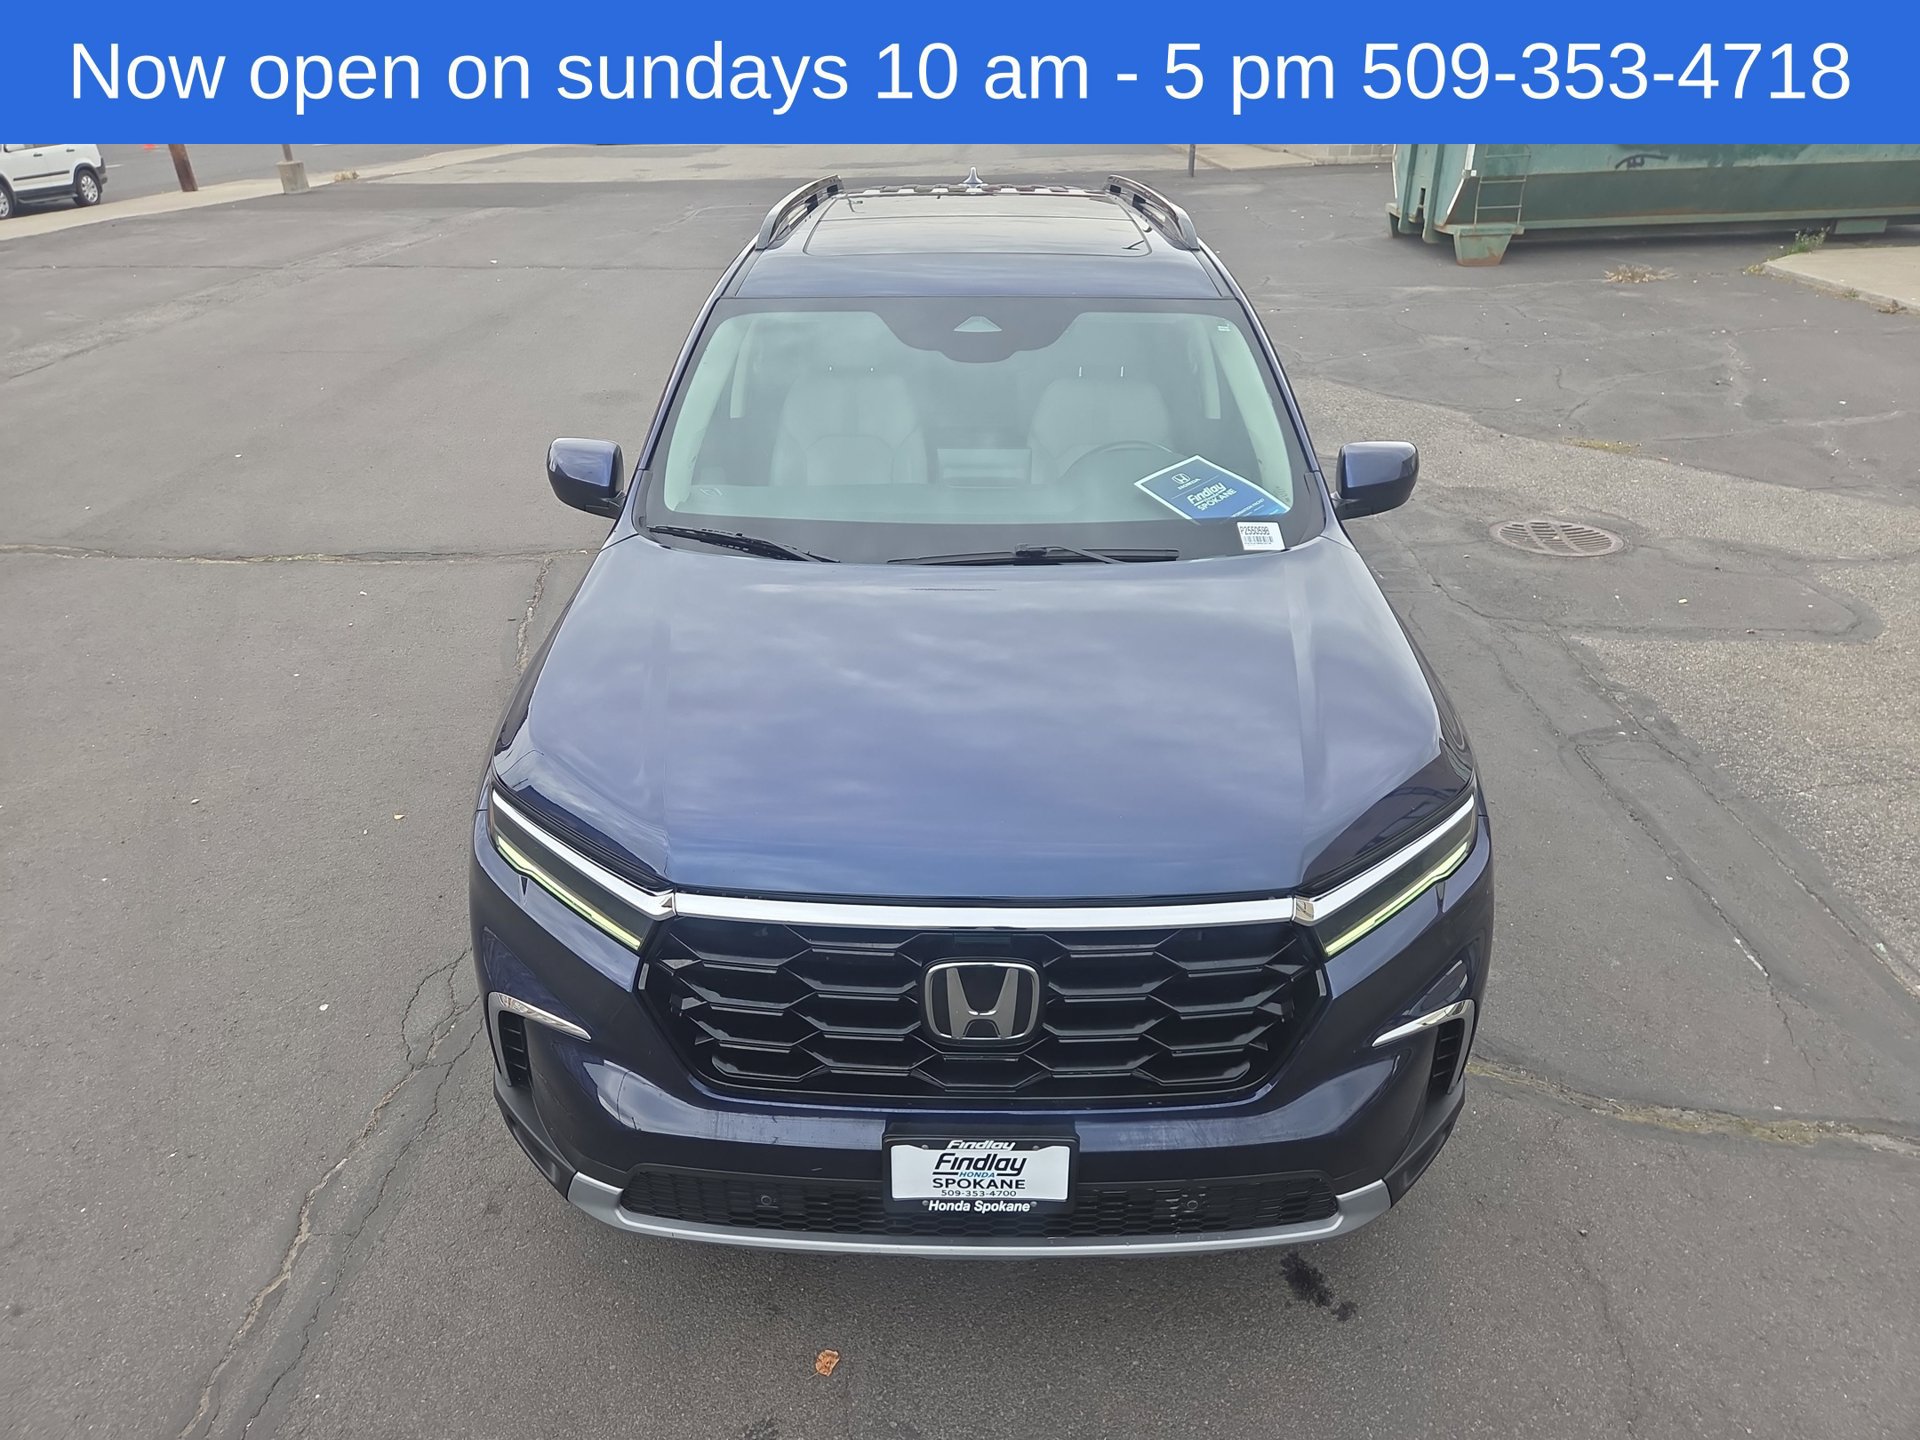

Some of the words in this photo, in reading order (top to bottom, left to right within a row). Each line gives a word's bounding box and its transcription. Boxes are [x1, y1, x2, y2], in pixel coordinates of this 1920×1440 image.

[1187, 482, 1227, 504] Findlay
[1197, 488, 1237, 511] SPOKANE
[946, 1140, 1016, 1151] Findlay
[934, 1153, 1028, 1176] Findlay
[932, 1178, 1026, 1190] SPOKANE
[928, 1200, 971, 1212] Honda
[974, 1200, 1031, 1214] Spokane
